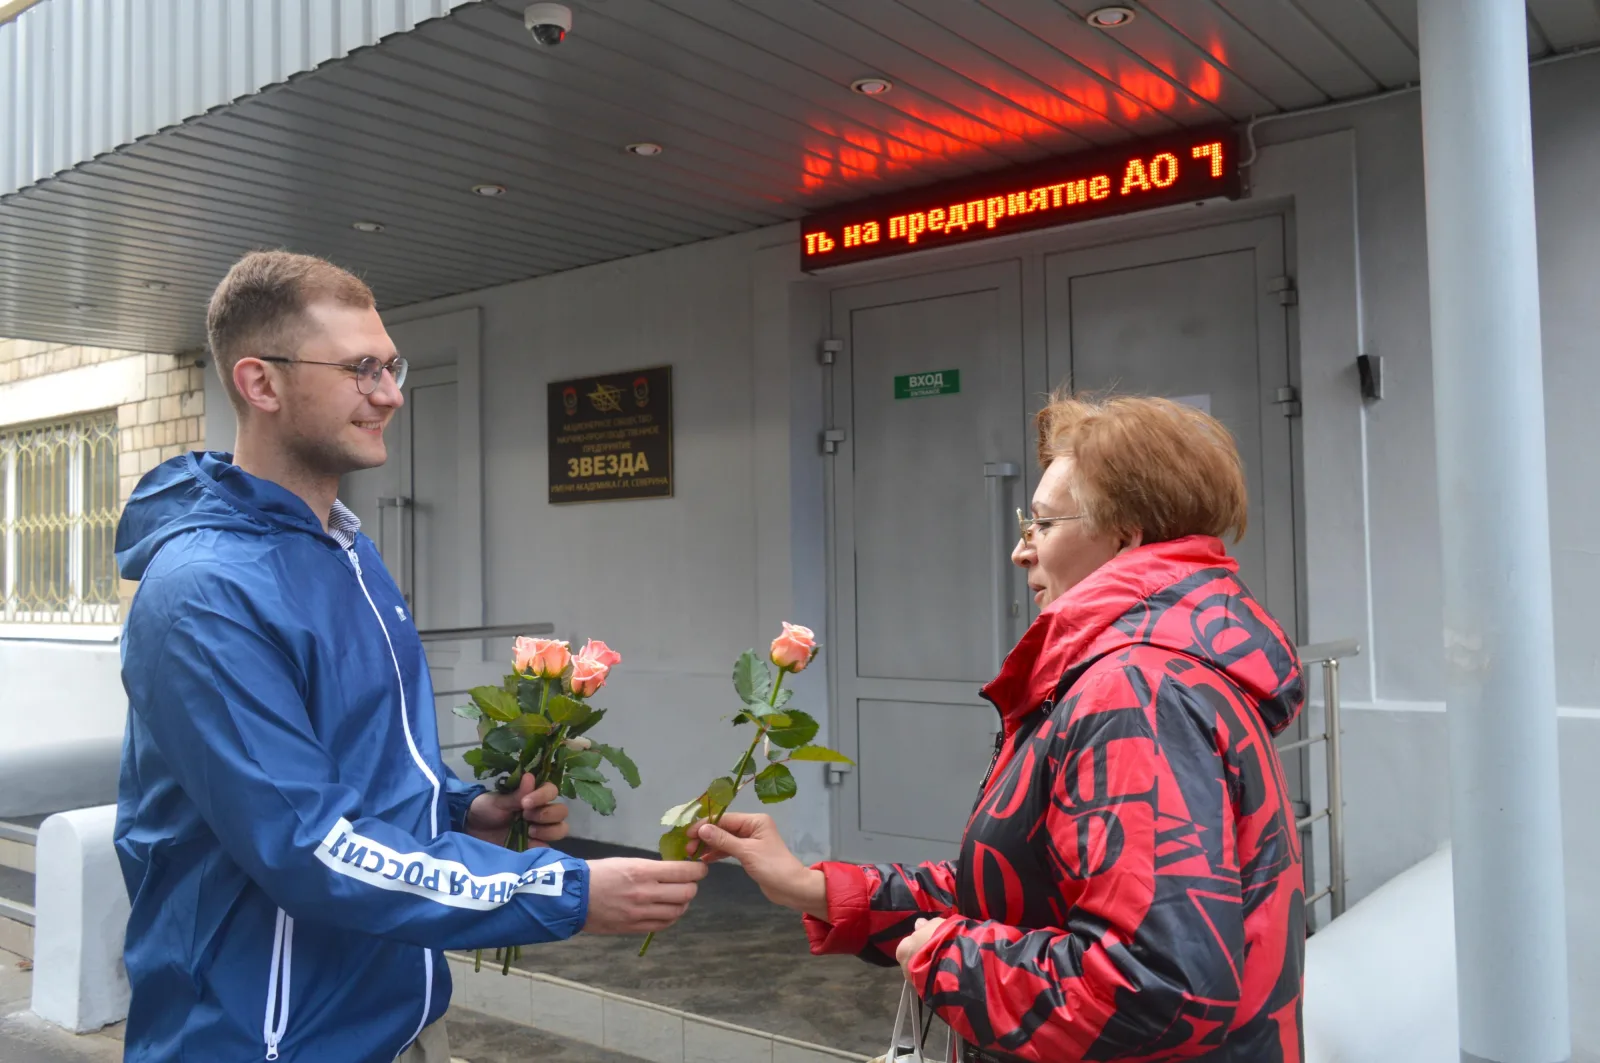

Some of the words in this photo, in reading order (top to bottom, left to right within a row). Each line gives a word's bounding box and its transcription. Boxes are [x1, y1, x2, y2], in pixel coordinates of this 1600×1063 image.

[844, 221, 880, 247] на
[889, 175, 1110, 244] предприятие
[1121, 152, 1178, 194] АО
[909, 373, 943, 388] ВХОД
[567, 451, 649, 478] ЗВЕЗДА
[327, 831, 440, 891] РОССИЯ
